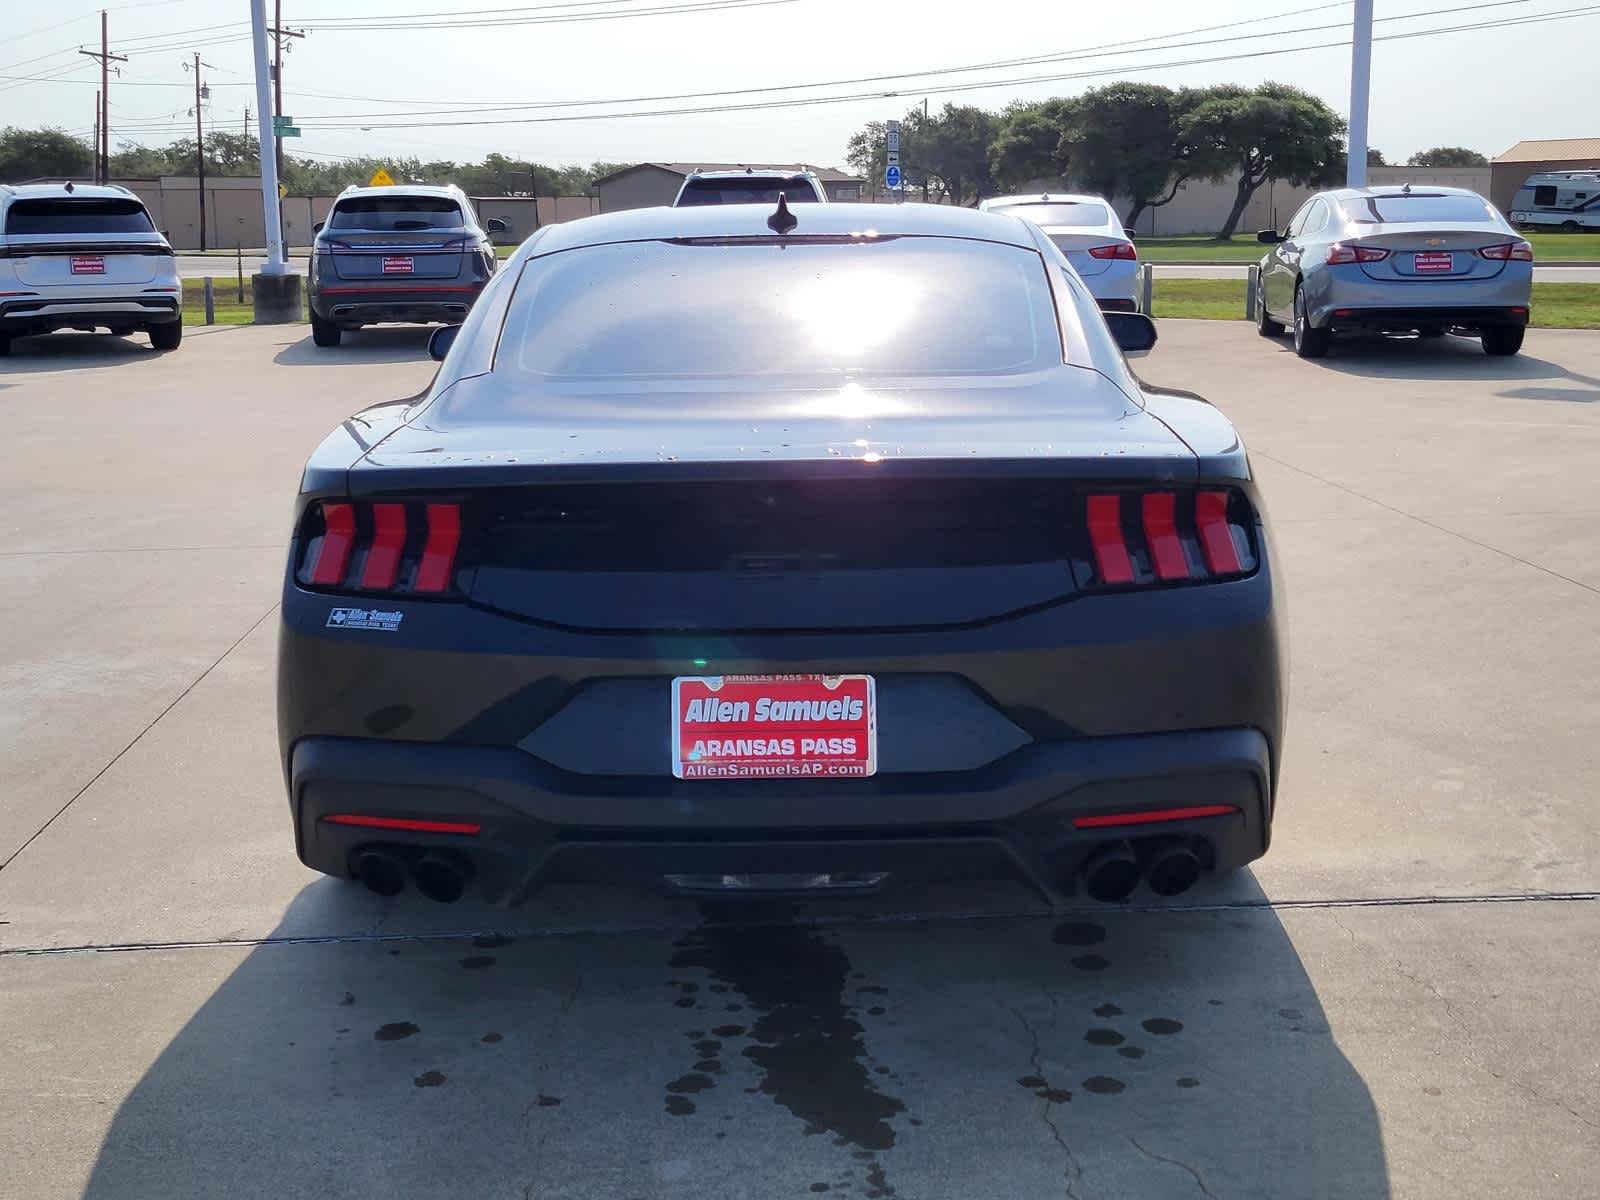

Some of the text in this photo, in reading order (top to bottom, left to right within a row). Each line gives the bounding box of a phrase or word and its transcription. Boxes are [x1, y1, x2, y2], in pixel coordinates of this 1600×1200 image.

[684, 696, 863, 722] Allen Samuels
[693, 738, 856, 757] ARANSAS PASS
[686, 763, 864, 776] AllenSamuelsAP.com
